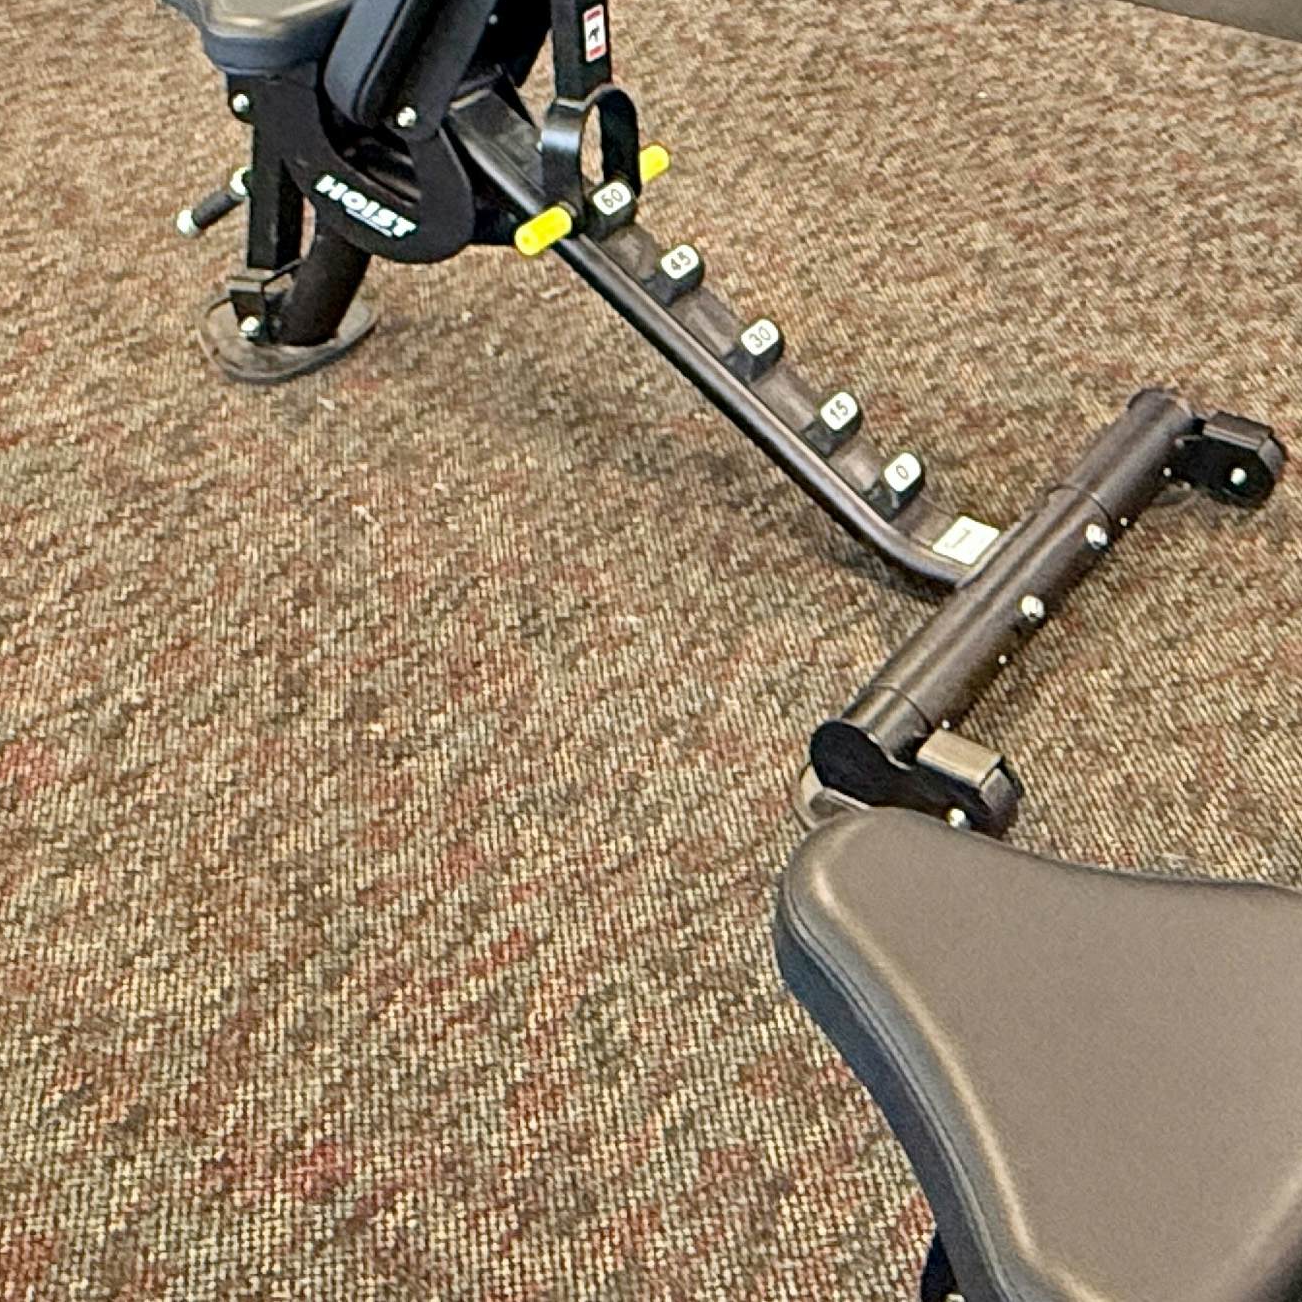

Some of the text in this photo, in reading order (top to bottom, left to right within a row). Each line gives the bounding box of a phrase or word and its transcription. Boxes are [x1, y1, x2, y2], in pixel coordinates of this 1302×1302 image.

[315, 174, 417, 238] HOIST
[601, 188, 624, 209] 60
[670, 251, 692, 271] 45
[748, 326, 772, 348] 30
[829, 399, 850, 422] 15
[895, 464, 910, 481] 0
